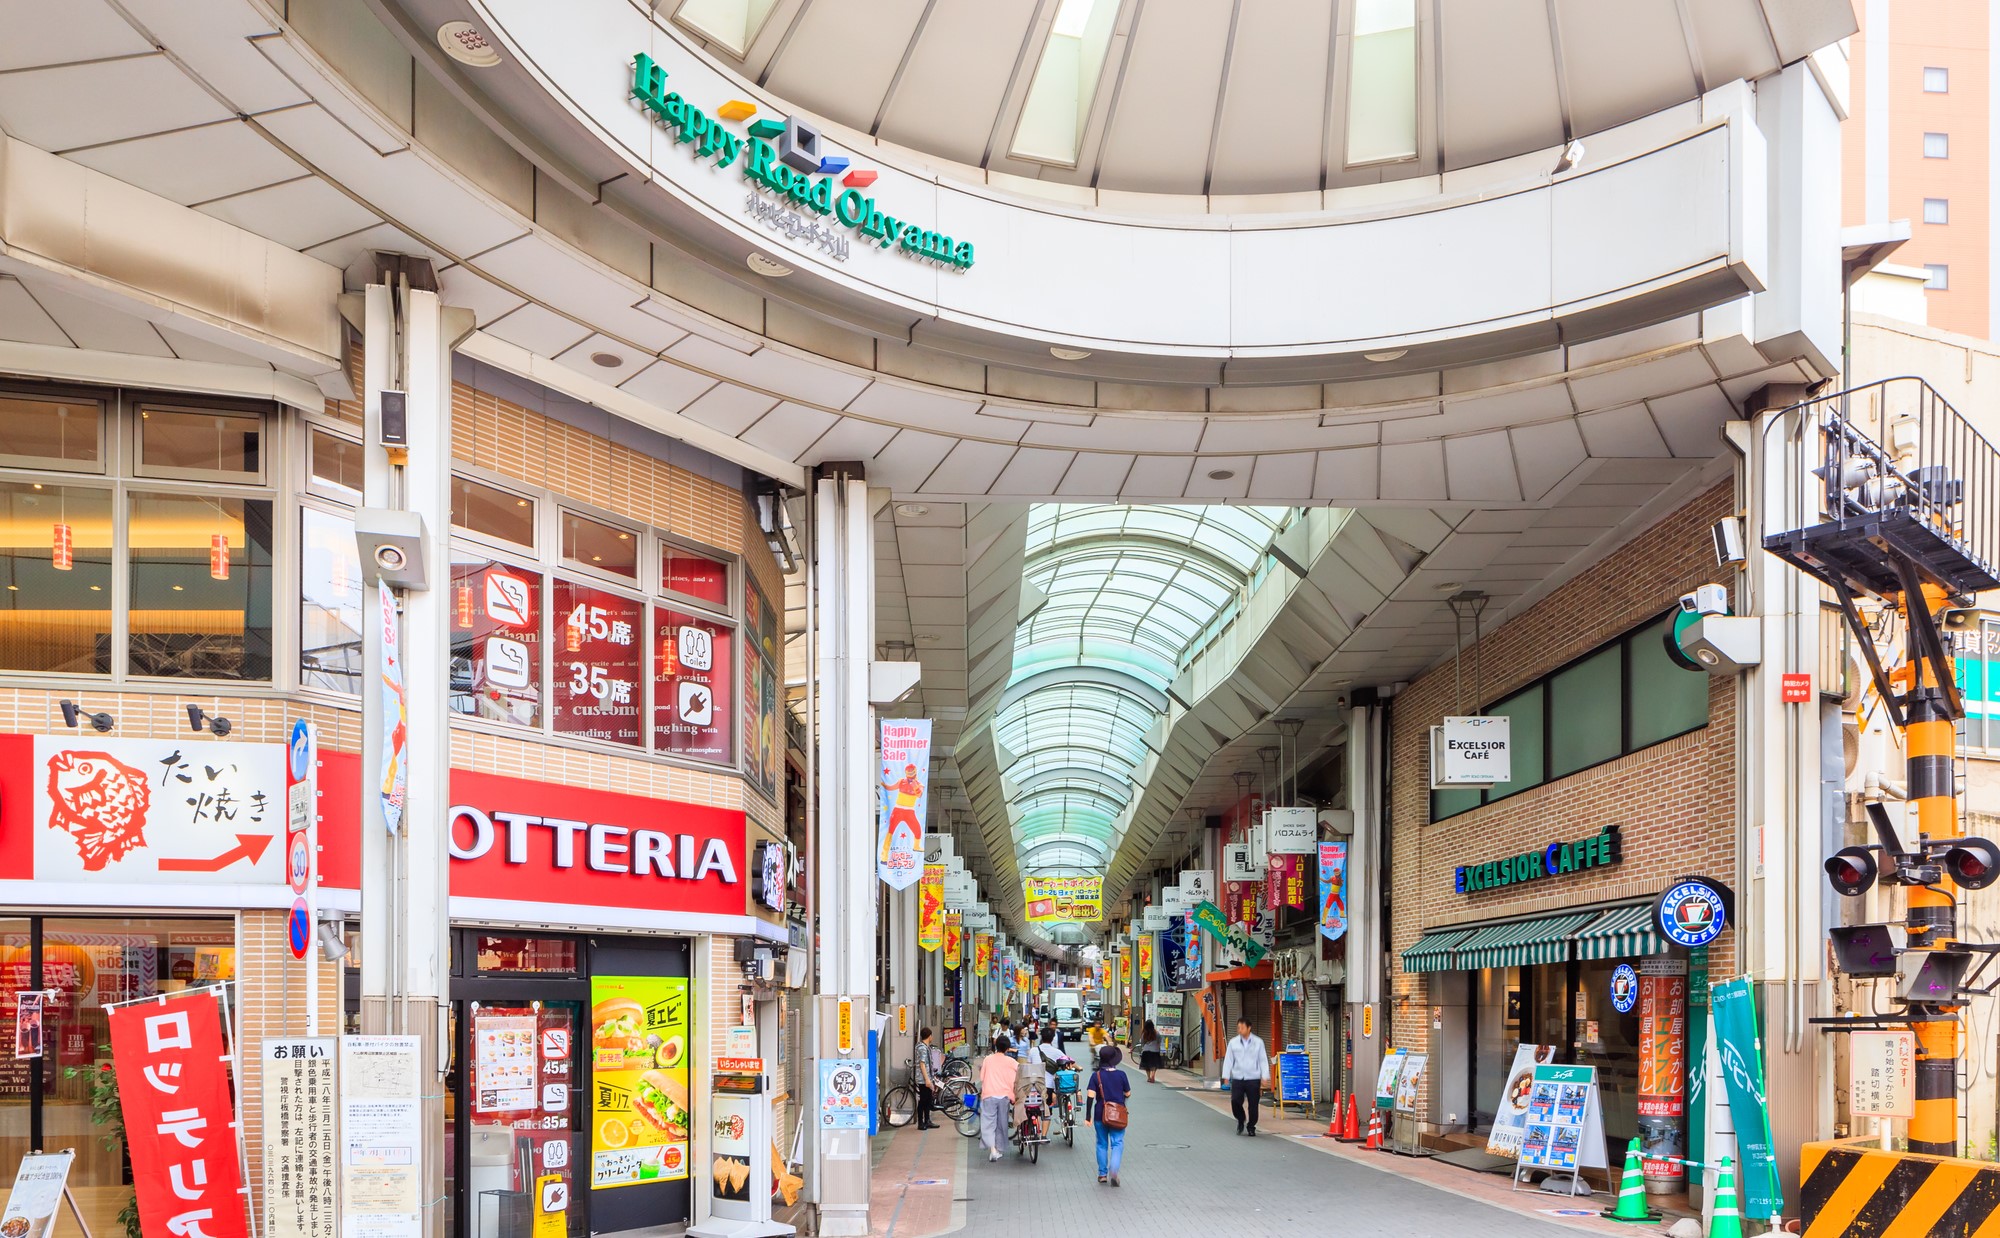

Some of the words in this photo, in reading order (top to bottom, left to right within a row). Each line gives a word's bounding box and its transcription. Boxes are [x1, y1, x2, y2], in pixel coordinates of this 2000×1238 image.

[631, 52, 745, 169] Happy
[743, 136, 833, 216] Road
[834, 187, 976, 270] Ohyama
[747, 192, 850, 261] ハッピーロード大山
[567, 603, 632, 646] 45席
[684, 654, 707, 669] Toilet
[569, 662, 632, 704] 35席
[1786, 689, 1807, 697] 作動中
[883, 725, 917, 738] Happy
[685, 746, 723, 754] atmosphere
[883, 736, 928, 749] Summer
[1448, 740, 1506, 750] EXCELSIOR
[883, 750, 907, 761] Sale
[1463, 749, 1490, 760] CAFÉ
[159, 749, 238, 787] たい
[185, 788, 269, 824] 焼き
[1320, 844, 1339, 852] Happy
[1320, 851, 1347, 859] Summer
[293, 850, 306, 878] 30
[886, 859, 916, 870] ロードマン
[1455, 850, 1541, 895] EXCELSIOR
[1027, 879, 1100, 888] ハローカードポイント
[1295, 855, 1305, 905] ハローカード
[1287, 877, 1297, 905] 加盟店
[1663, 886, 1722, 915] EXCELSIOR
[646, 1001, 682, 1027] 夏エビ
[67, 1040, 85, 1048] EBI
[1642, 977, 1653, 1093] お部屋さがし
[1669, 978, 1684, 1095] お部屋さがし
[273, 1045, 324, 1060] お願い
[599, 1053, 622, 1063] 新発売
[1654, 1017, 1672, 1094] エイブル
[719, 1060, 761, 1070] いらっしゃいませ
[1885, 1040, 1895, 1109] 鳴り始めてからの
[11, 1076, 26, 1084] We
[1870, 1067, 1880, 1112] 踏切横断
[280, 1077, 290, 1147] 警視庁板橋警察署
[1494, 1131, 1523, 1146] MORNING
